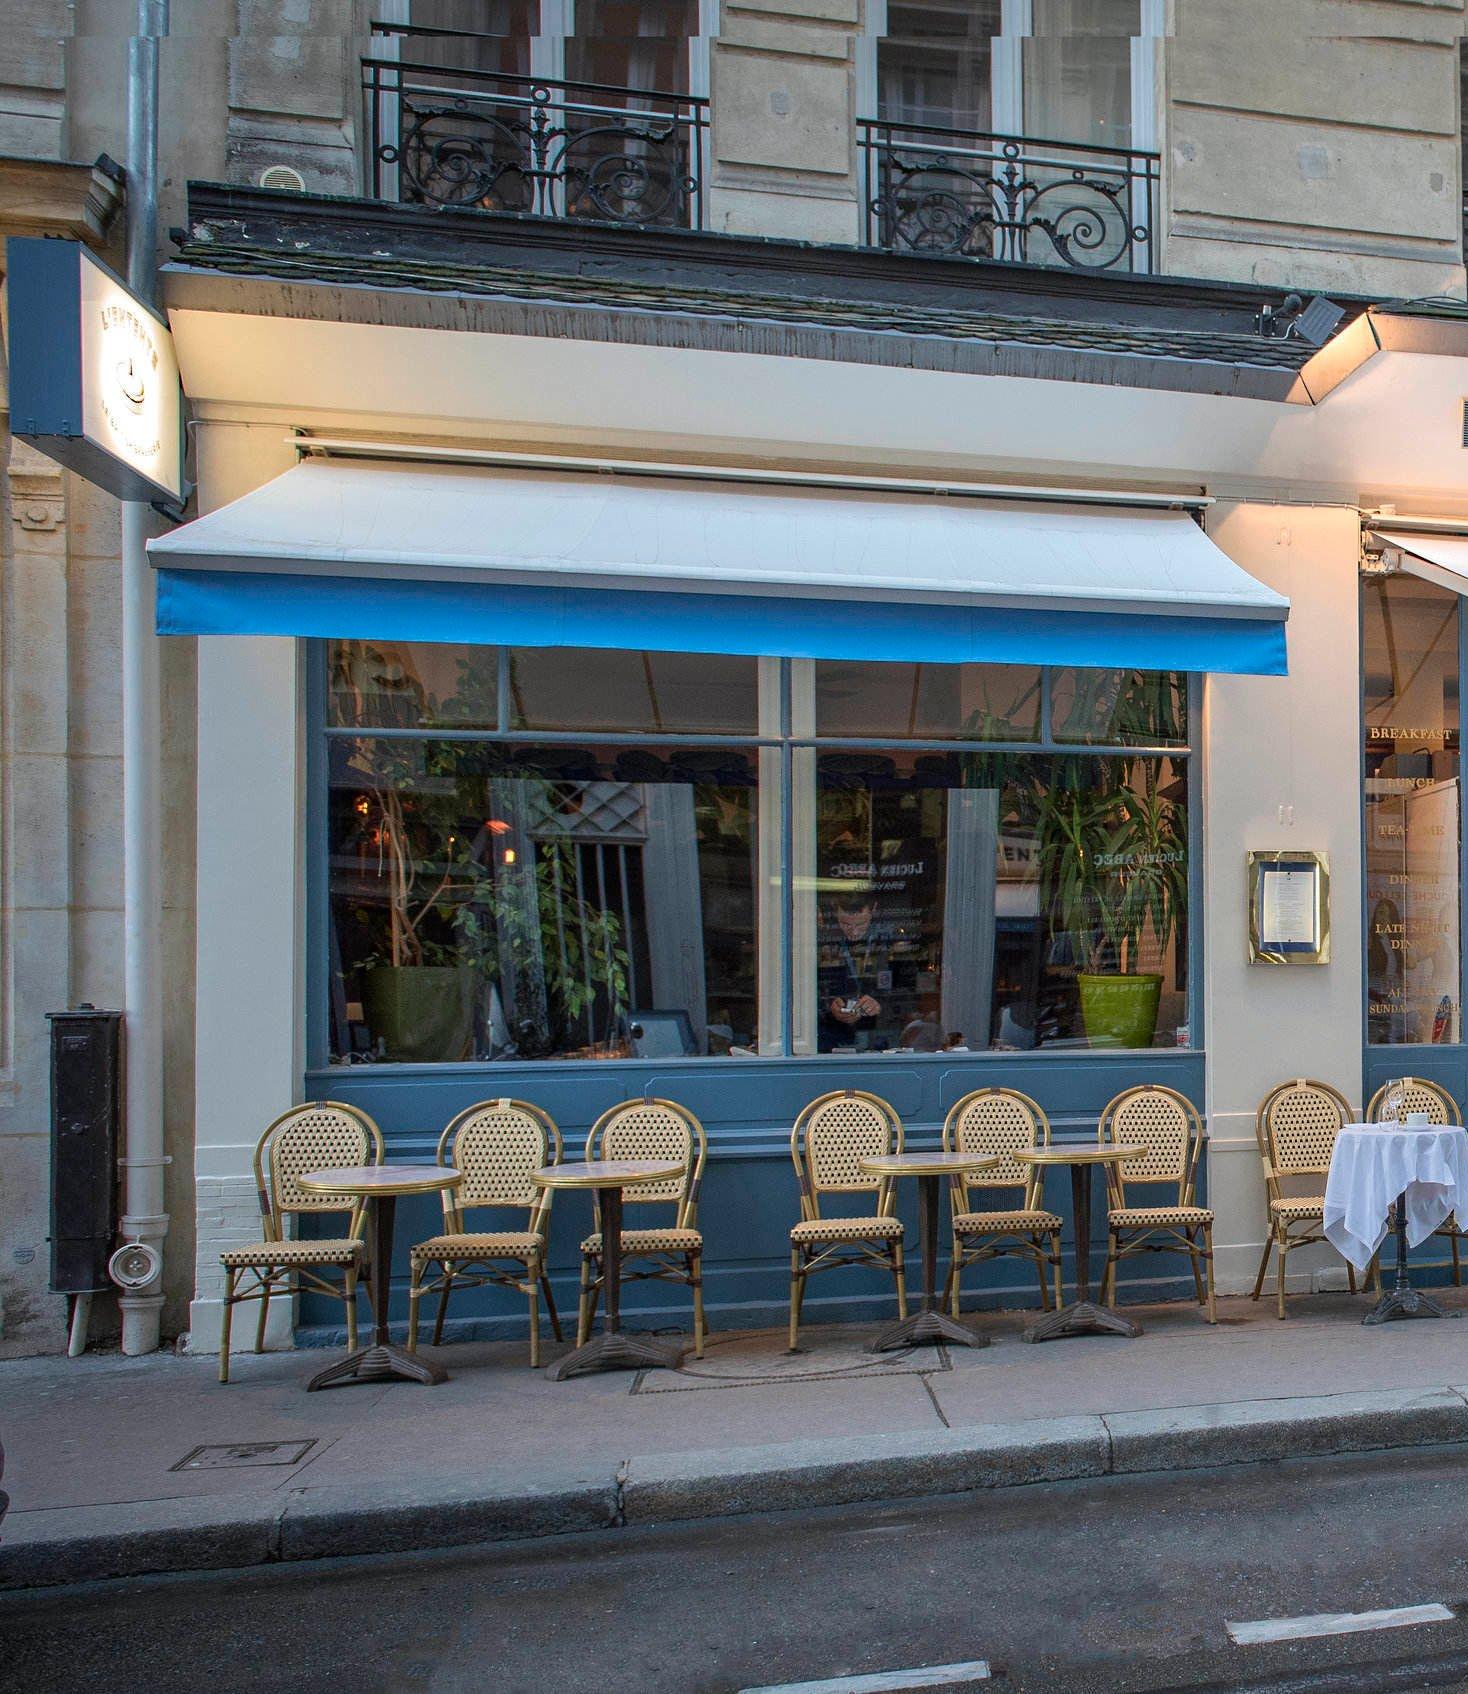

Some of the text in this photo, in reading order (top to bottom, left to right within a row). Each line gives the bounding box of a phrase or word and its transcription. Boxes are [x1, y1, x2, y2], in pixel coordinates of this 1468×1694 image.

[1370, 727, 1452, 740] BREAKFAST
[1388, 777, 1435, 788] LUNCH
[1378, 825, 1446, 836] TEA-ME
[1389, 874, 1440, 886] DINR
[1375, 923, 1407, 934] LATE
